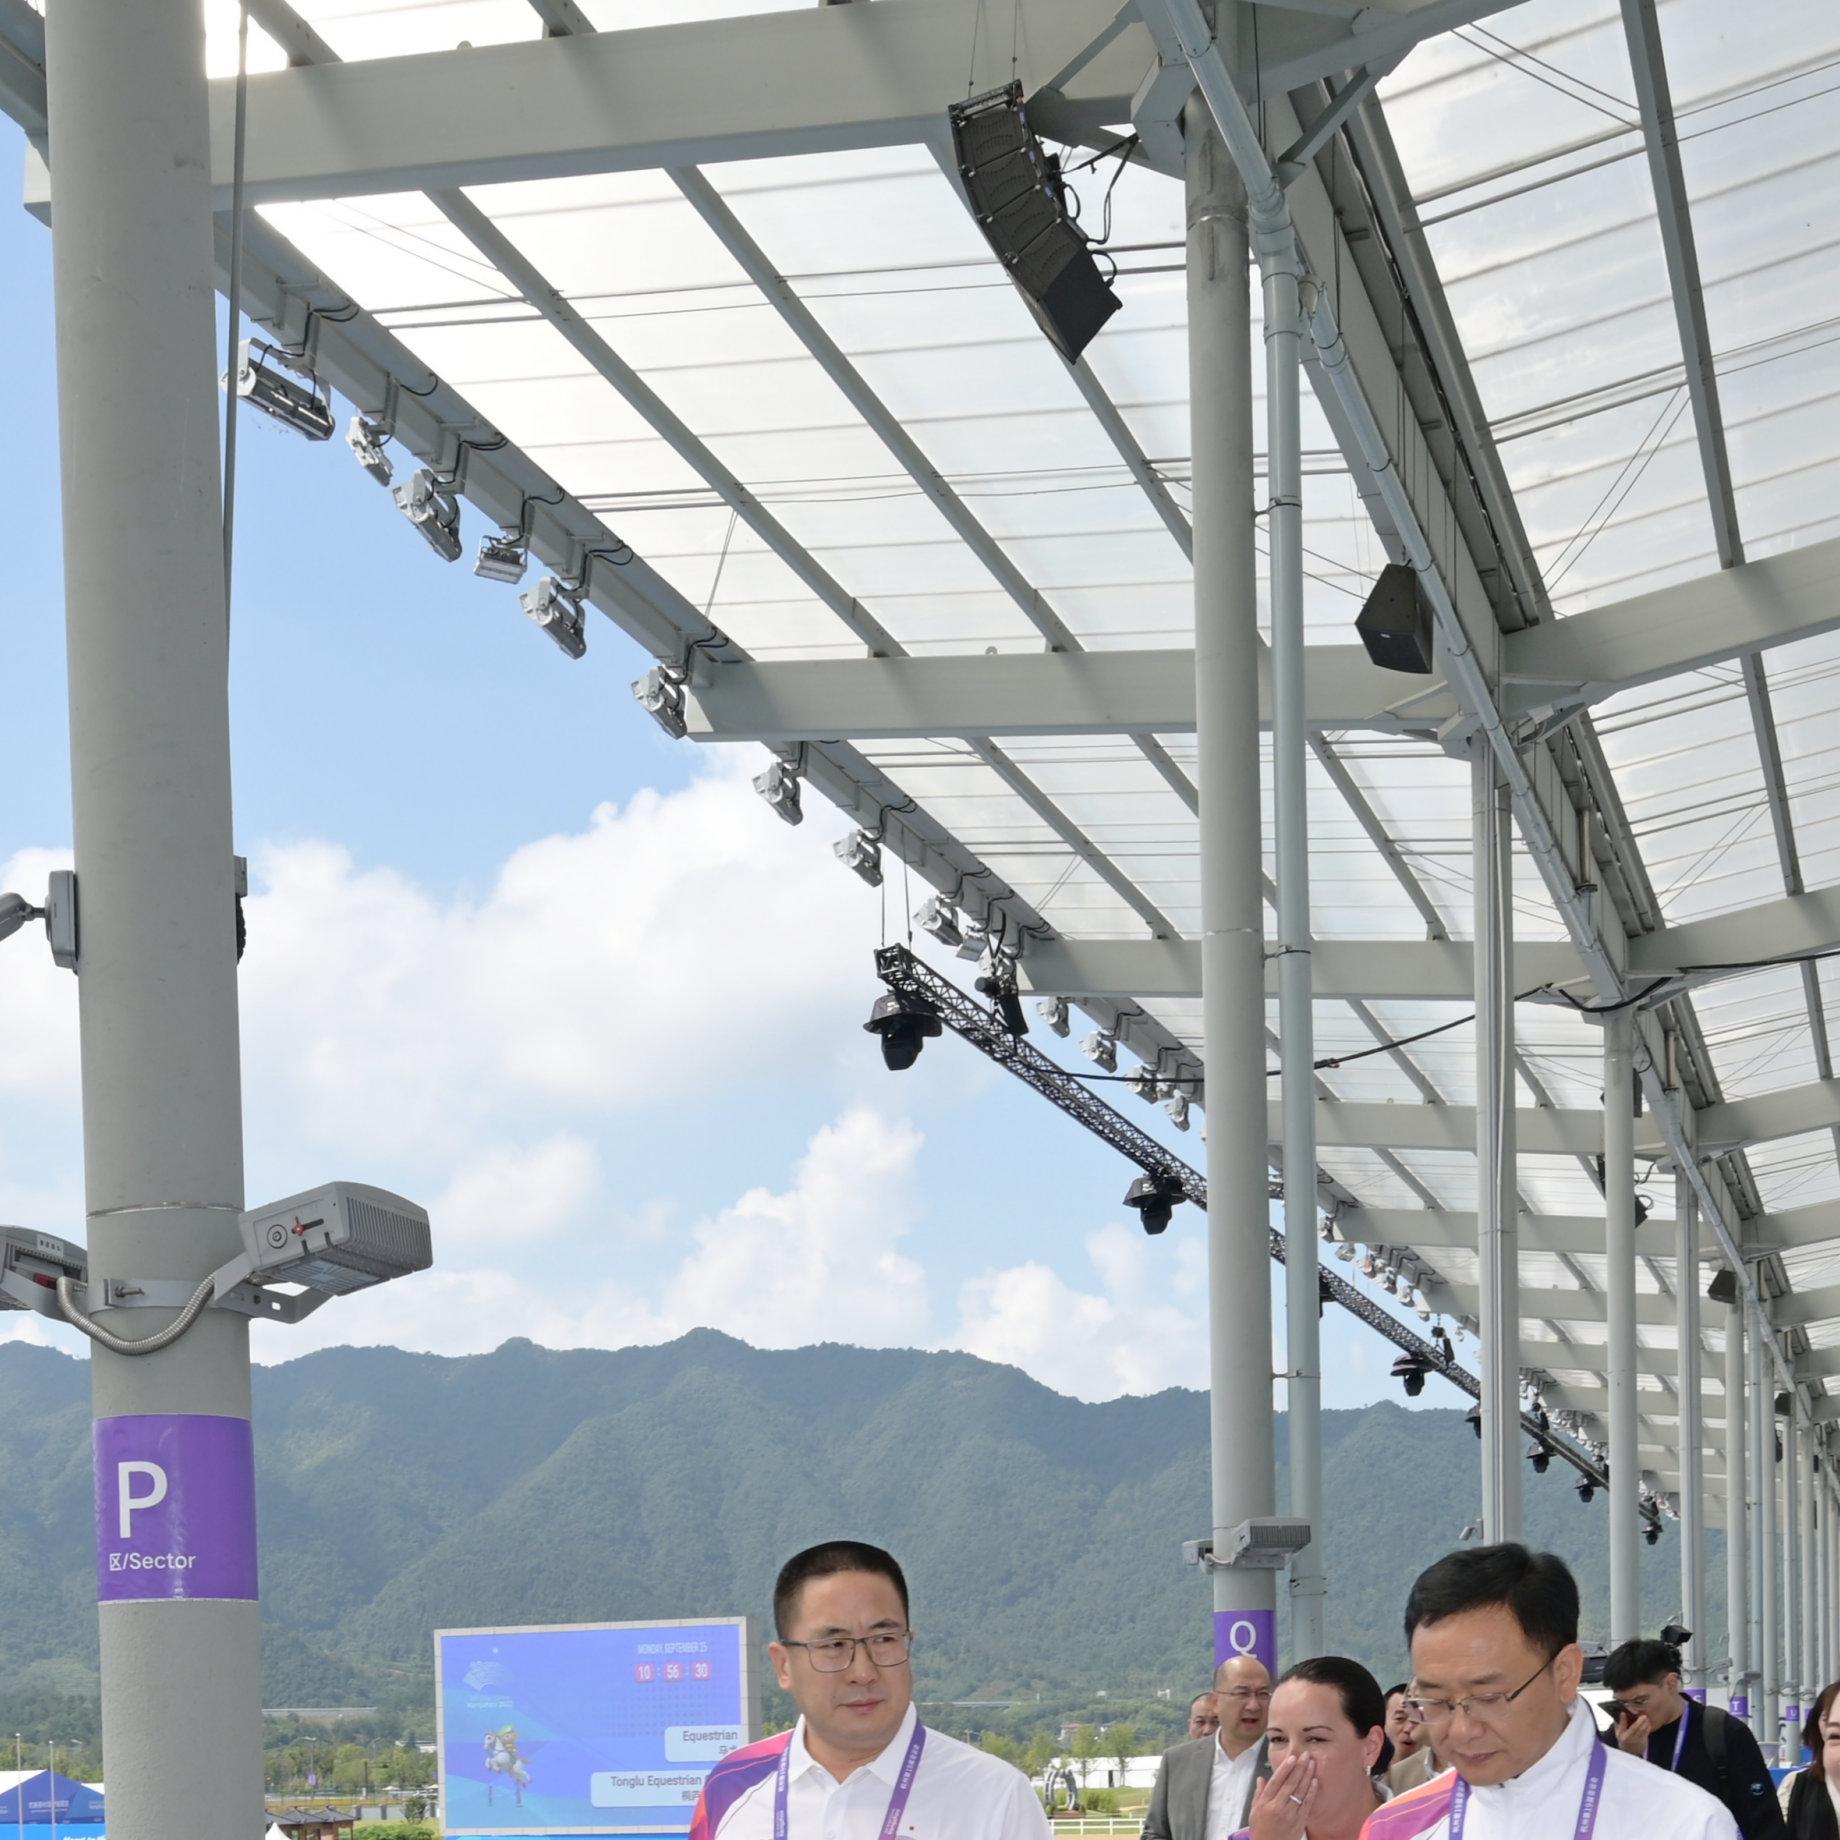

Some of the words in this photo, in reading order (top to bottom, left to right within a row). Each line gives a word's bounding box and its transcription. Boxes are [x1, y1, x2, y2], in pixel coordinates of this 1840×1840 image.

[118, 1461, 168, 1539] P
[109, 1552, 196, 1572] 区/Sector
[1230, 1620, 1257, 1658] Q
[683, 1731, 738, 1744] Equestrian
[610, 1775, 644, 1789] Tonglu
[647, 1774, 702, 1788] Equestrian
